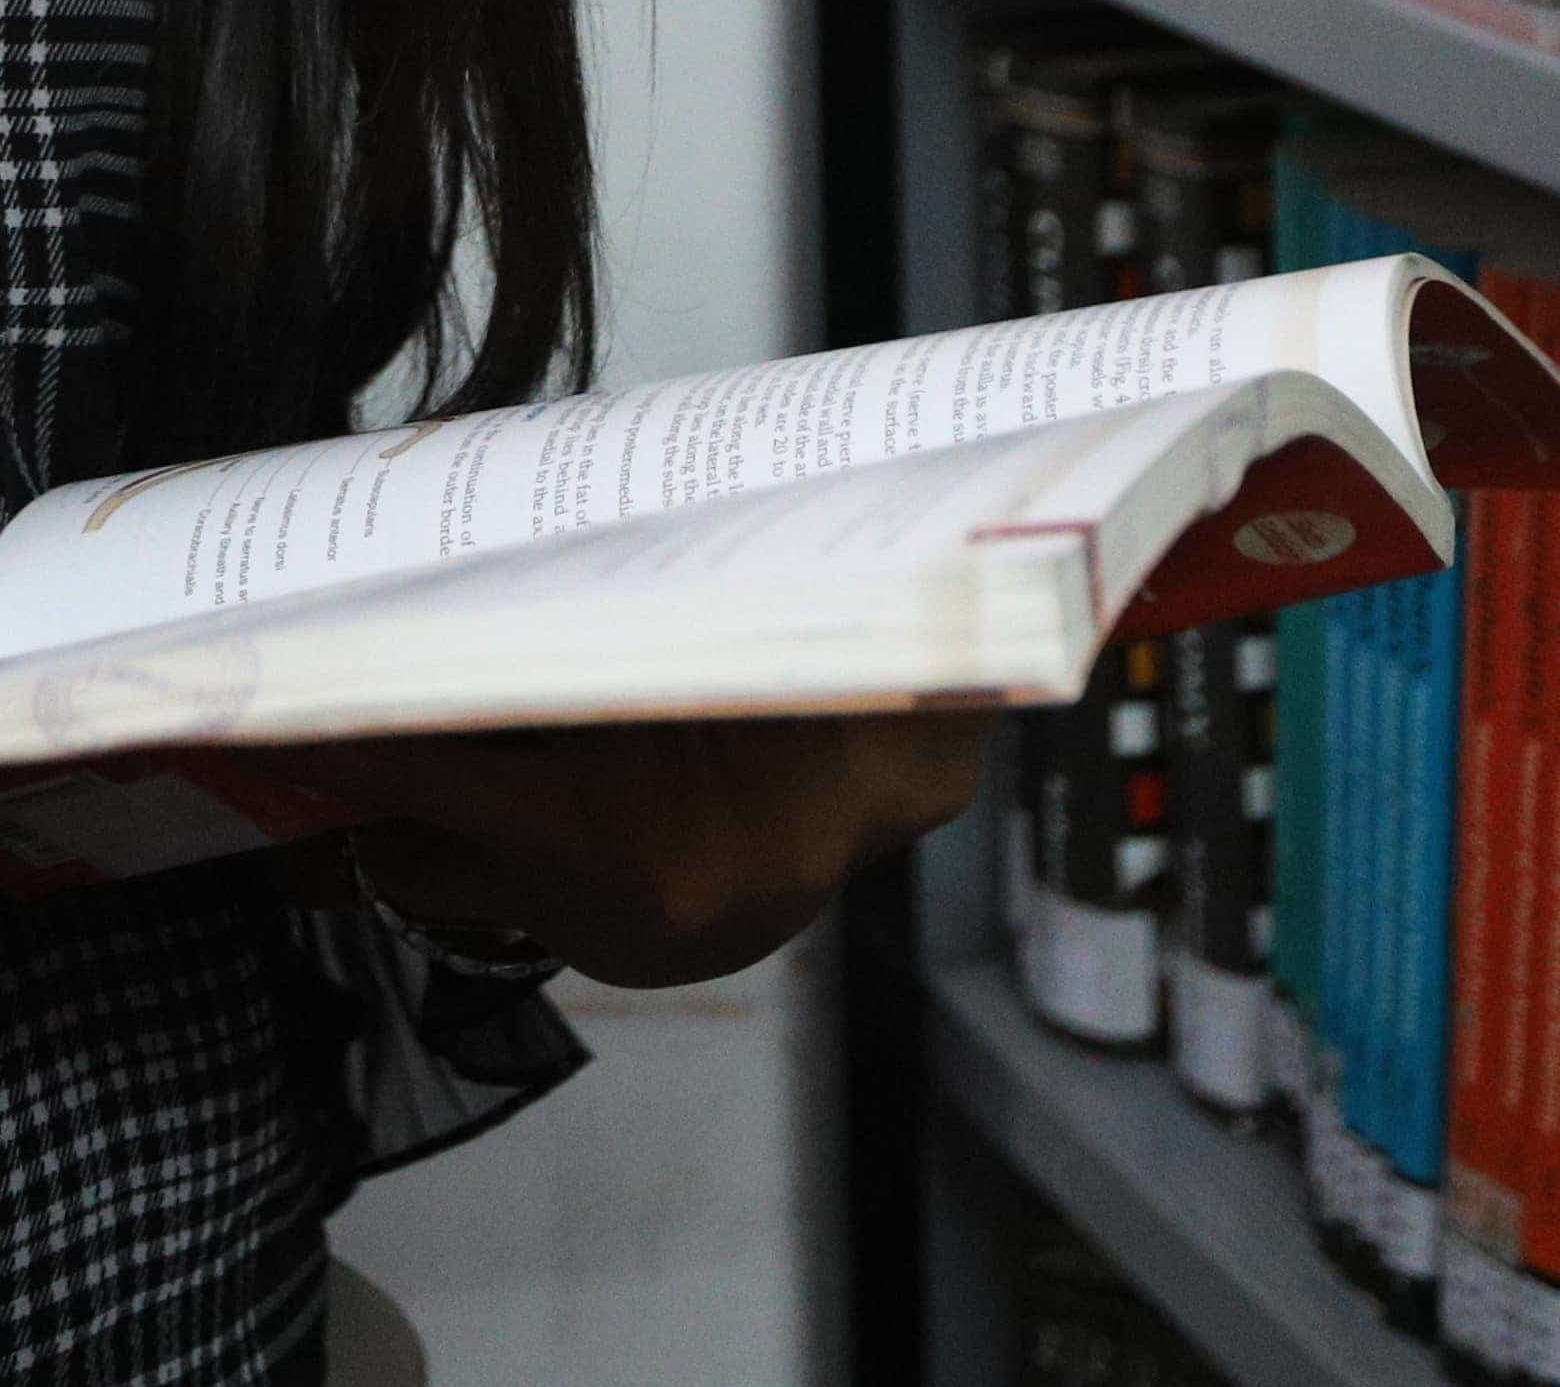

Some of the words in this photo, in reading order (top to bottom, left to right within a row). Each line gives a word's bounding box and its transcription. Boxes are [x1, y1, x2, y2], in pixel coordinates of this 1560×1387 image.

[726, 415, 748, 453] along
[884, 401, 899, 455] surface
[662, 447, 675, 467] the
[681, 435, 704, 474] along
[772, 437, 788, 454] 20
[795, 436, 810, 460] the
[817, 439, 832, 467] and
[576, 460, 591, 481] the
[706, 440, 724, 485] lateral
[728, 455, 743, 479] the
[772, 461, 786, 477] to
[441, 471, 460, 506] outer
[462, 444, 489, 524] continuation
[535, 469, 549, 484] to
[533, 487, 547, 511] the
[554, 462, 573, 516] behind
[575, 484, 590, 505] fat
[662, 472, 676, 508] subs
[684, 480, 700, 504] the
[575, 510, 590, 529] of
[439, 509, 455, 556] borde
[460, 530, 477, 547] of
[238, 539, 254, 586] serratus
[274, 542, 289, 572] dorsi
[213, 581, 227, 605] and
